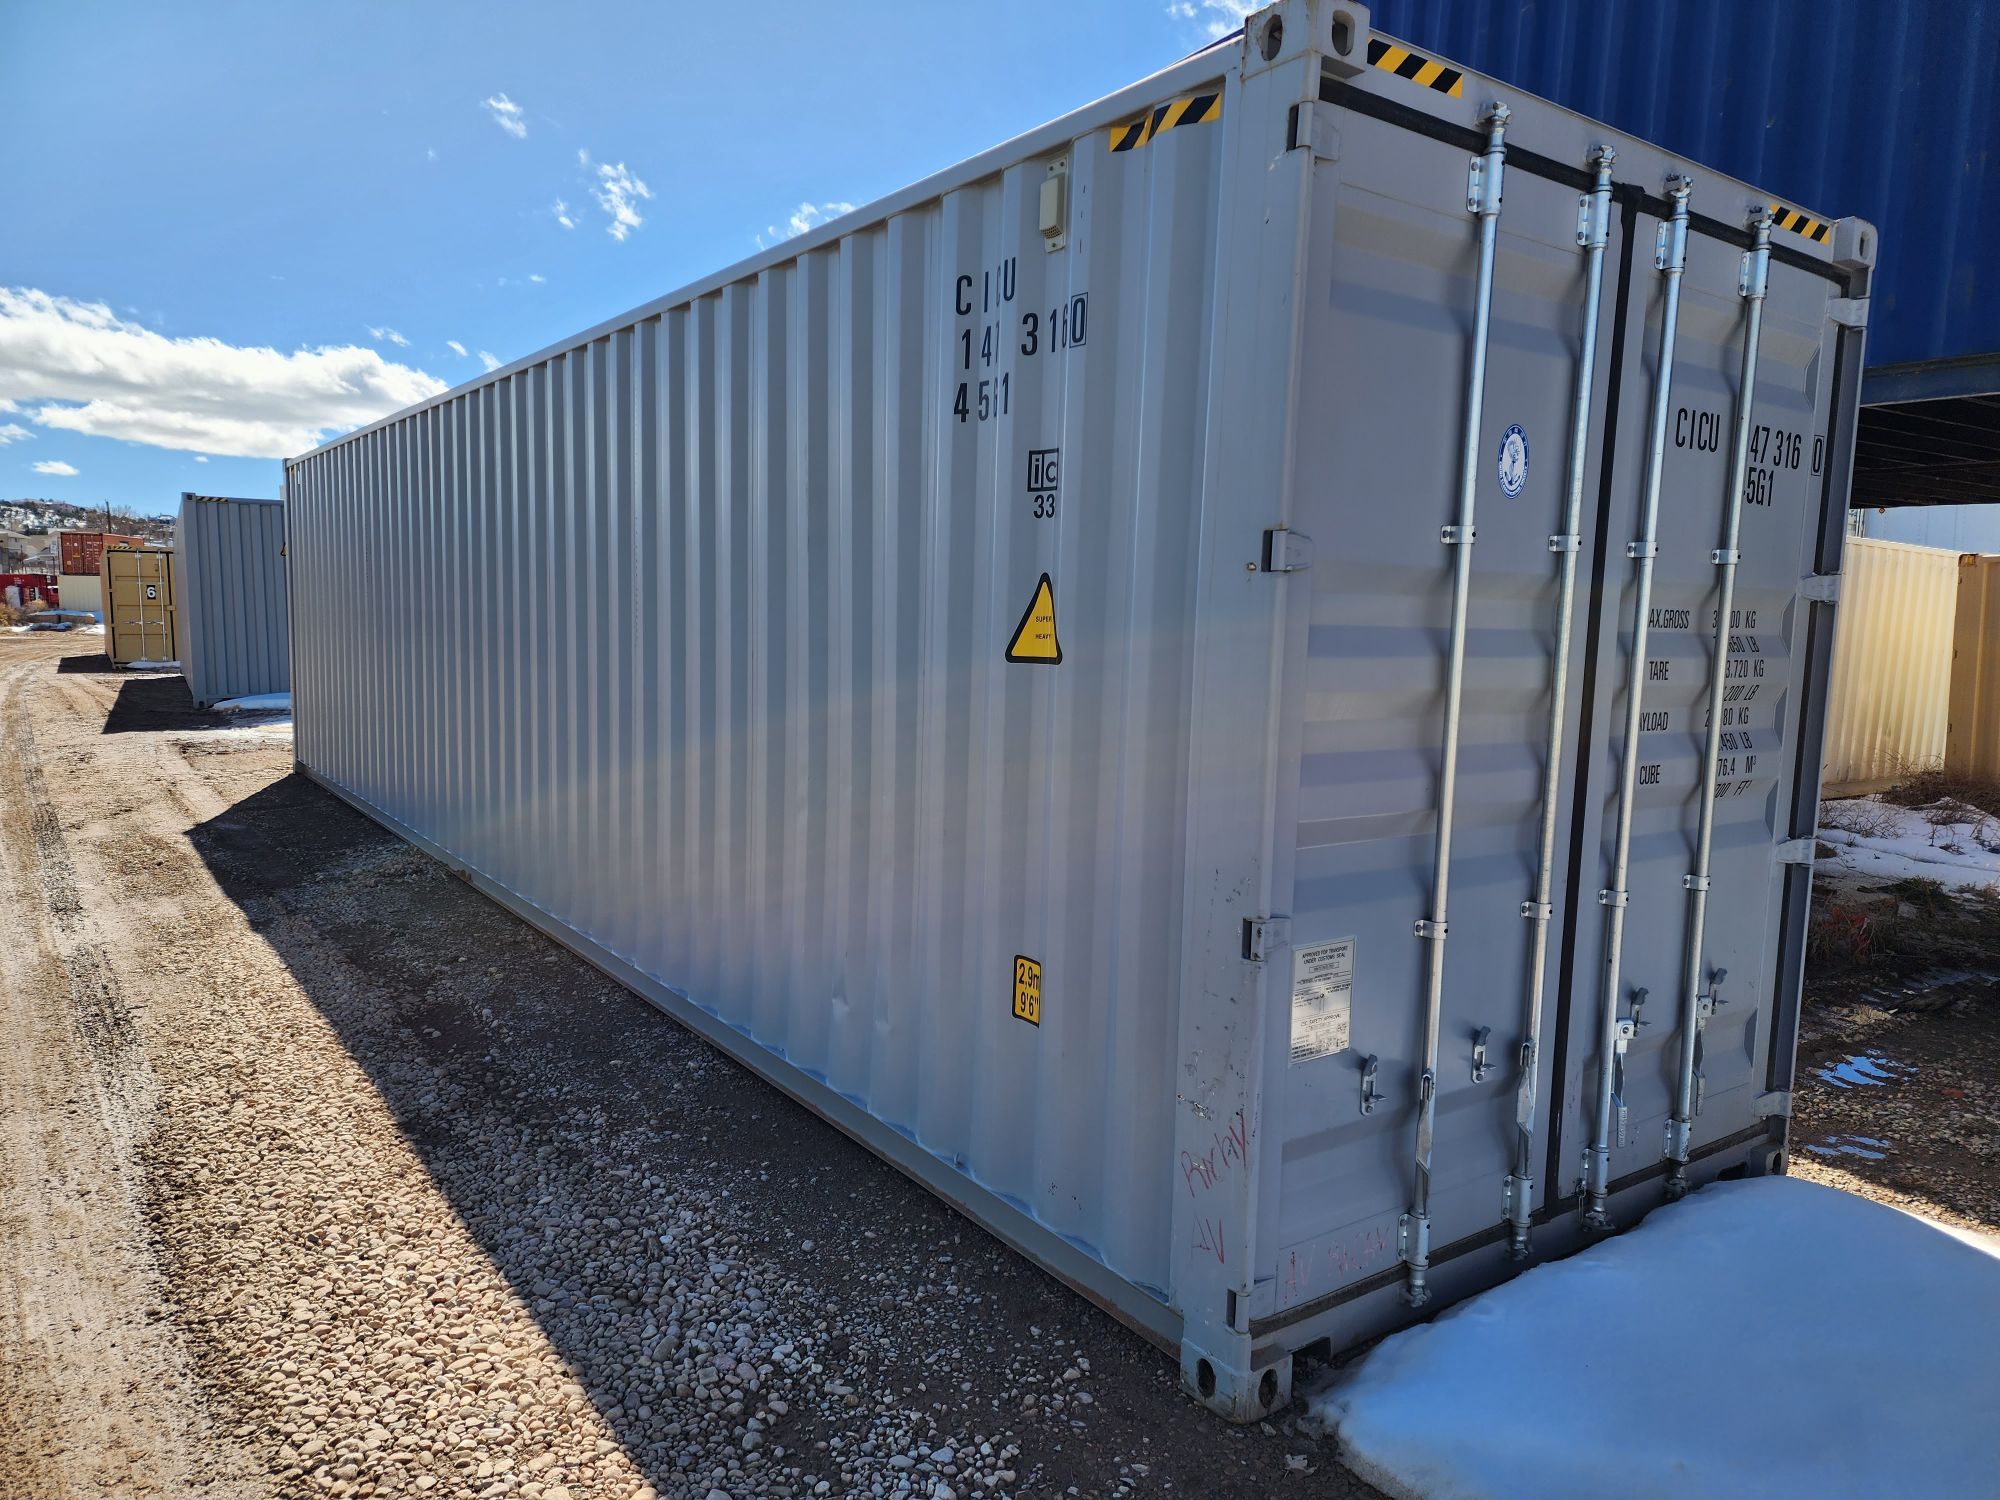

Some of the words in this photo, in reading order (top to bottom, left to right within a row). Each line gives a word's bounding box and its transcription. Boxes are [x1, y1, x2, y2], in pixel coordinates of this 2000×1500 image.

[1675, 407, 1720, 453] CICU
[1750, 424, 1771, 464] 47
[1773, 430, 1802, 470] 316
[1744, 466, 1775, 507] 5G1
[1033, 494, 1056, 519] 33
[147, 586, 156, 598] 6
[1035, 615, 1053, 623] SUPER
[1648, 608, 1690, 629] AX.GROSS
[1745, 610, 1757, 629] KG
[1745, 636, 1760, 653] LB
[1649, 661, 1670, 681] TARE
[1753, 659, 1765, 678] KG
[1743, 684, 1760, 701] LB
[1738, 706, 1750, 726] KG
[1739, 731, 1753, 749] LB
[1639, 764, 1661, 785] CUBE
[1714, 782, 1732, 799] 700
